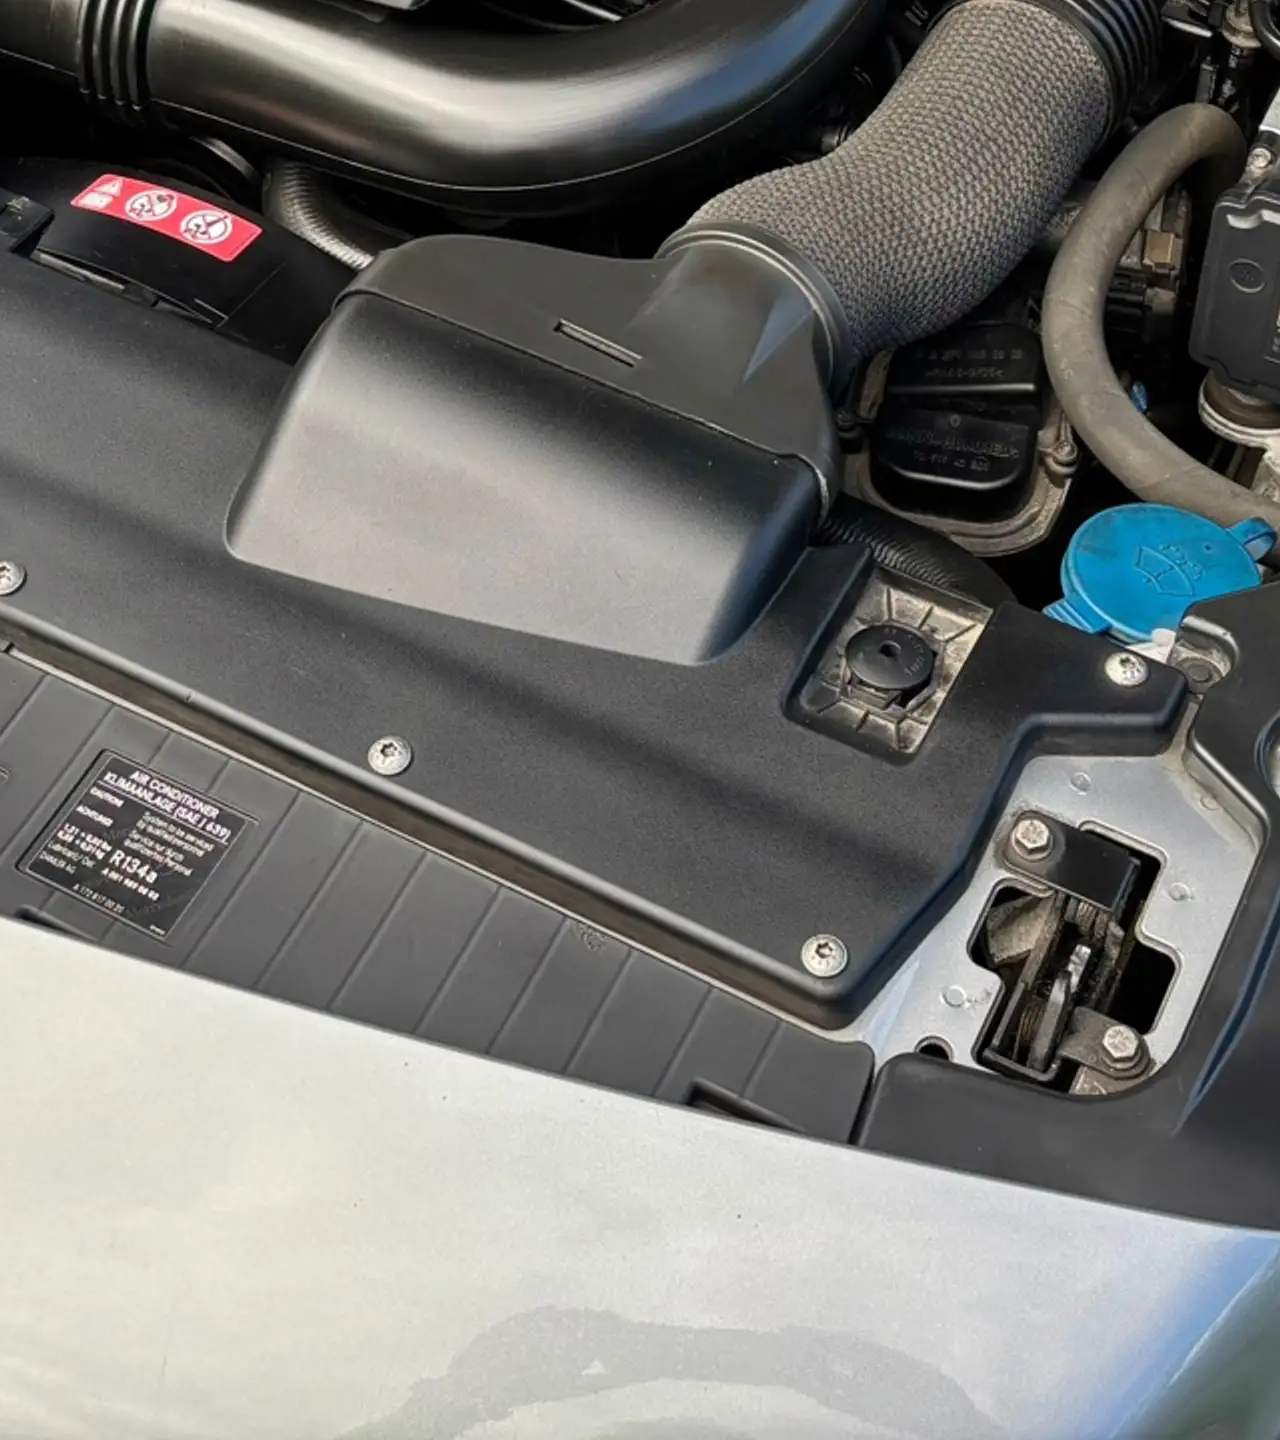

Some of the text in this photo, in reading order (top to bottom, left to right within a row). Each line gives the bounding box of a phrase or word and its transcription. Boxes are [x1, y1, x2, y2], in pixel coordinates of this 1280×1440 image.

[103, 772, 176, 812] KLIMAANLAGE
[130, 771, 220, 819] AIR CONDITIONER
[108, 850, 160, 884] R134a
